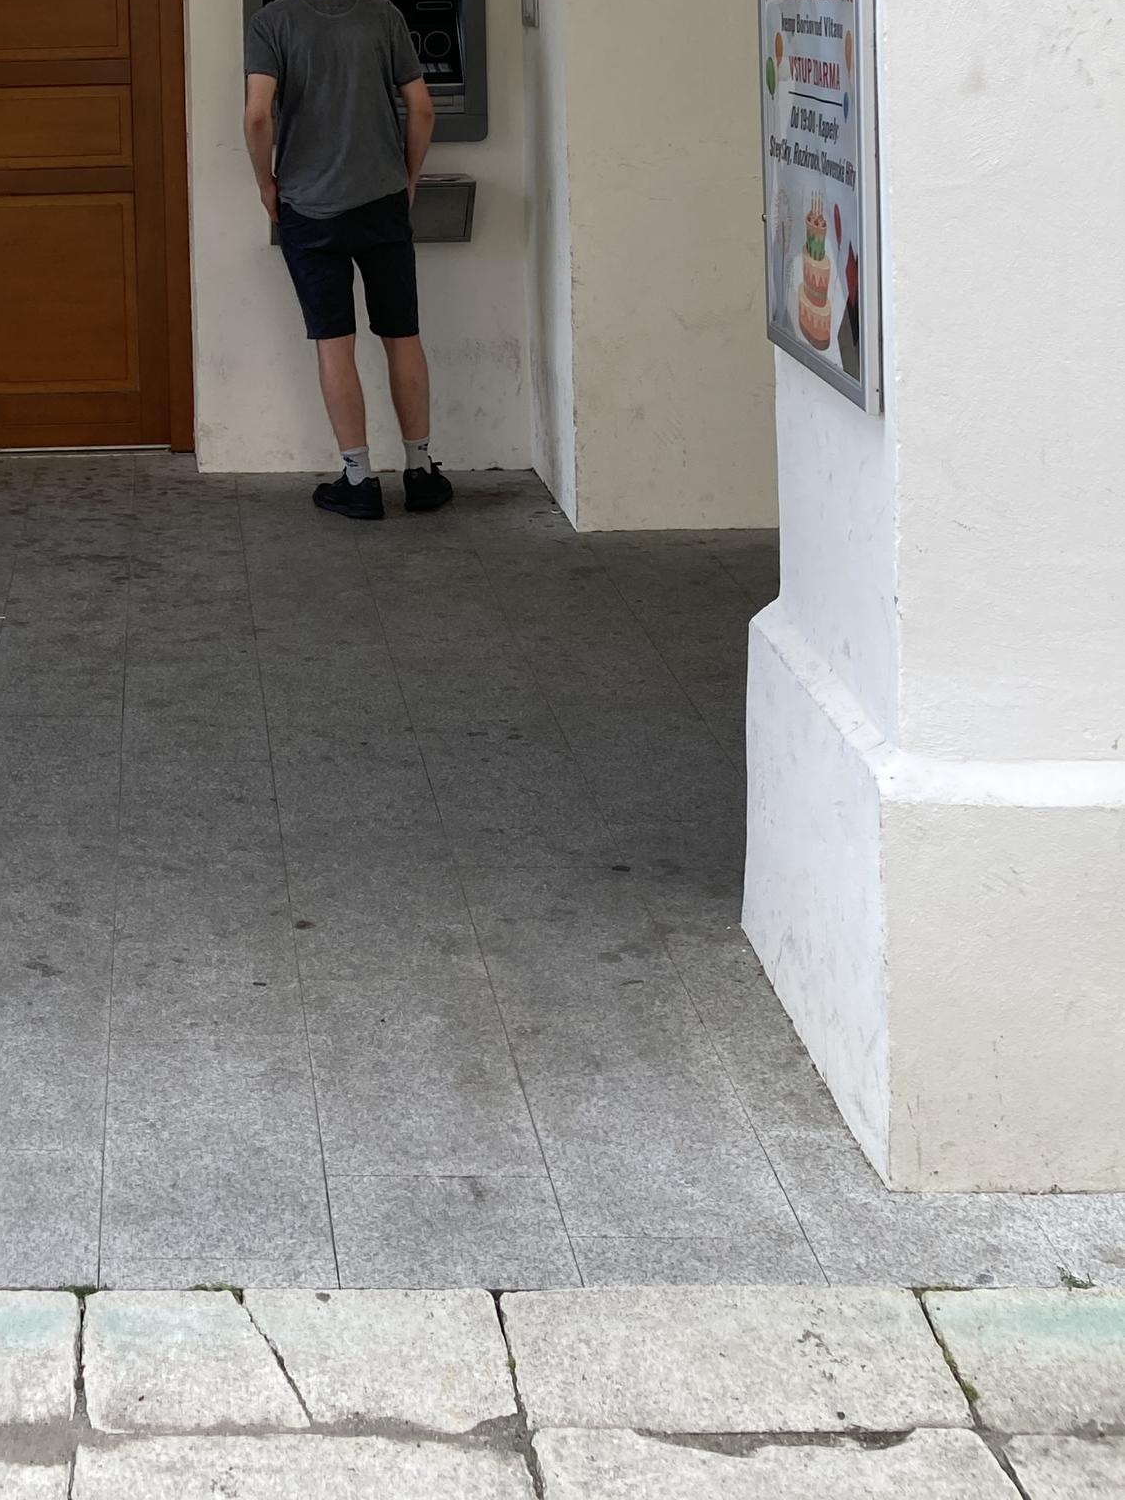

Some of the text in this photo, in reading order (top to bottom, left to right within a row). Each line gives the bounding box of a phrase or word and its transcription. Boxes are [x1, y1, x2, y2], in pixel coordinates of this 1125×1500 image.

[789, 56, 841, 90] VSTUP ZDARMA
[790, 105, 800, 129] Od
